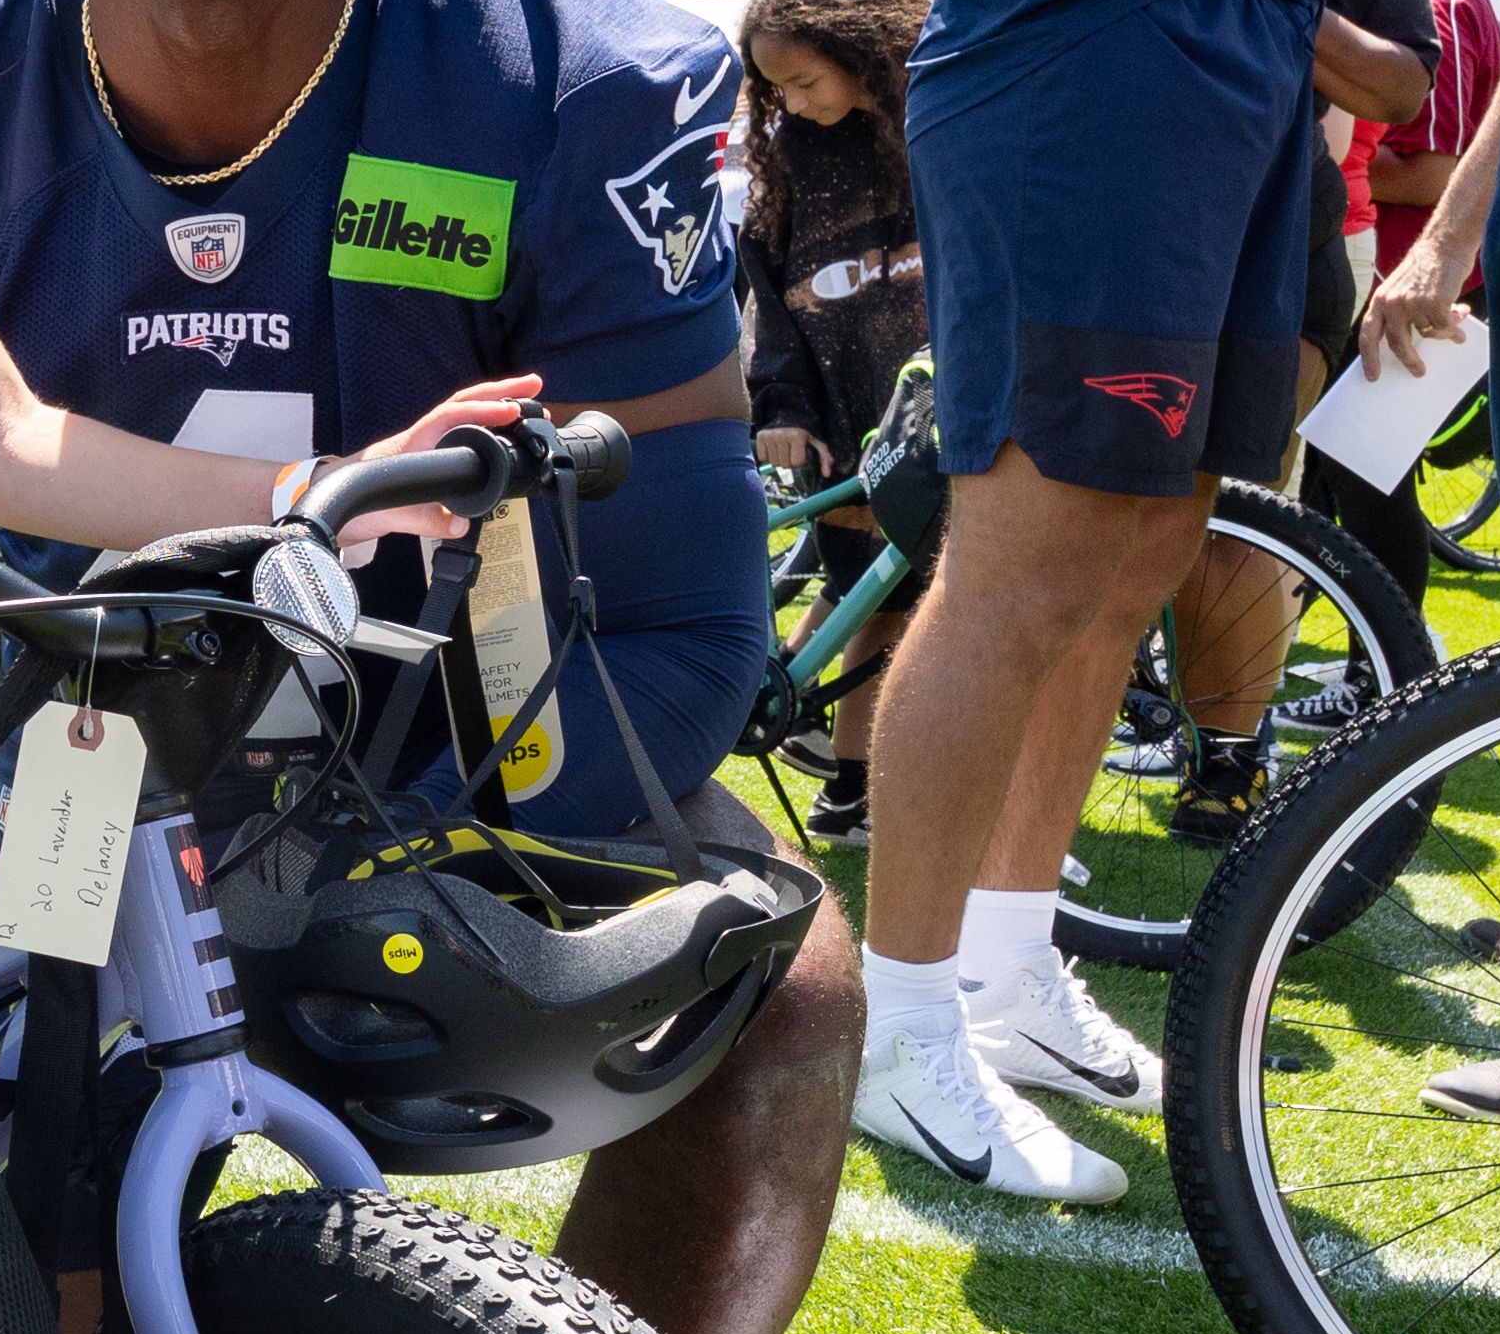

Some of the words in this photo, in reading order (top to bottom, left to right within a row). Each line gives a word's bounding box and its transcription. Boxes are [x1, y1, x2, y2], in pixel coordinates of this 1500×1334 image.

[177, 223, 237, 241] EQUIPMENT
[335, 198, 492, 268] Gillette
[195, 251, 224, 270] NFL
[811, 258, 923, 299] Cham
[127, 312, 290, 356] PATRIOTS
[866, 441, 890, 475] GOOD
[870, 440, 907, 488] SPORTS
[1319, 546, 1352, 579] XR1
[480, 661, 521, 677] AFETY
[485, 677, 513, 690] FOR
[484, 687, 531, 704] LMETS
[247, 751, 271, 765] NFL
[504, 743, 541, 766] ps
[38, 788, 73, 864] Lavender
[76, 819, 126, 907] Delaney
[29, 882, 53, 911] 20
[387, 946, 416, 959] Mips
